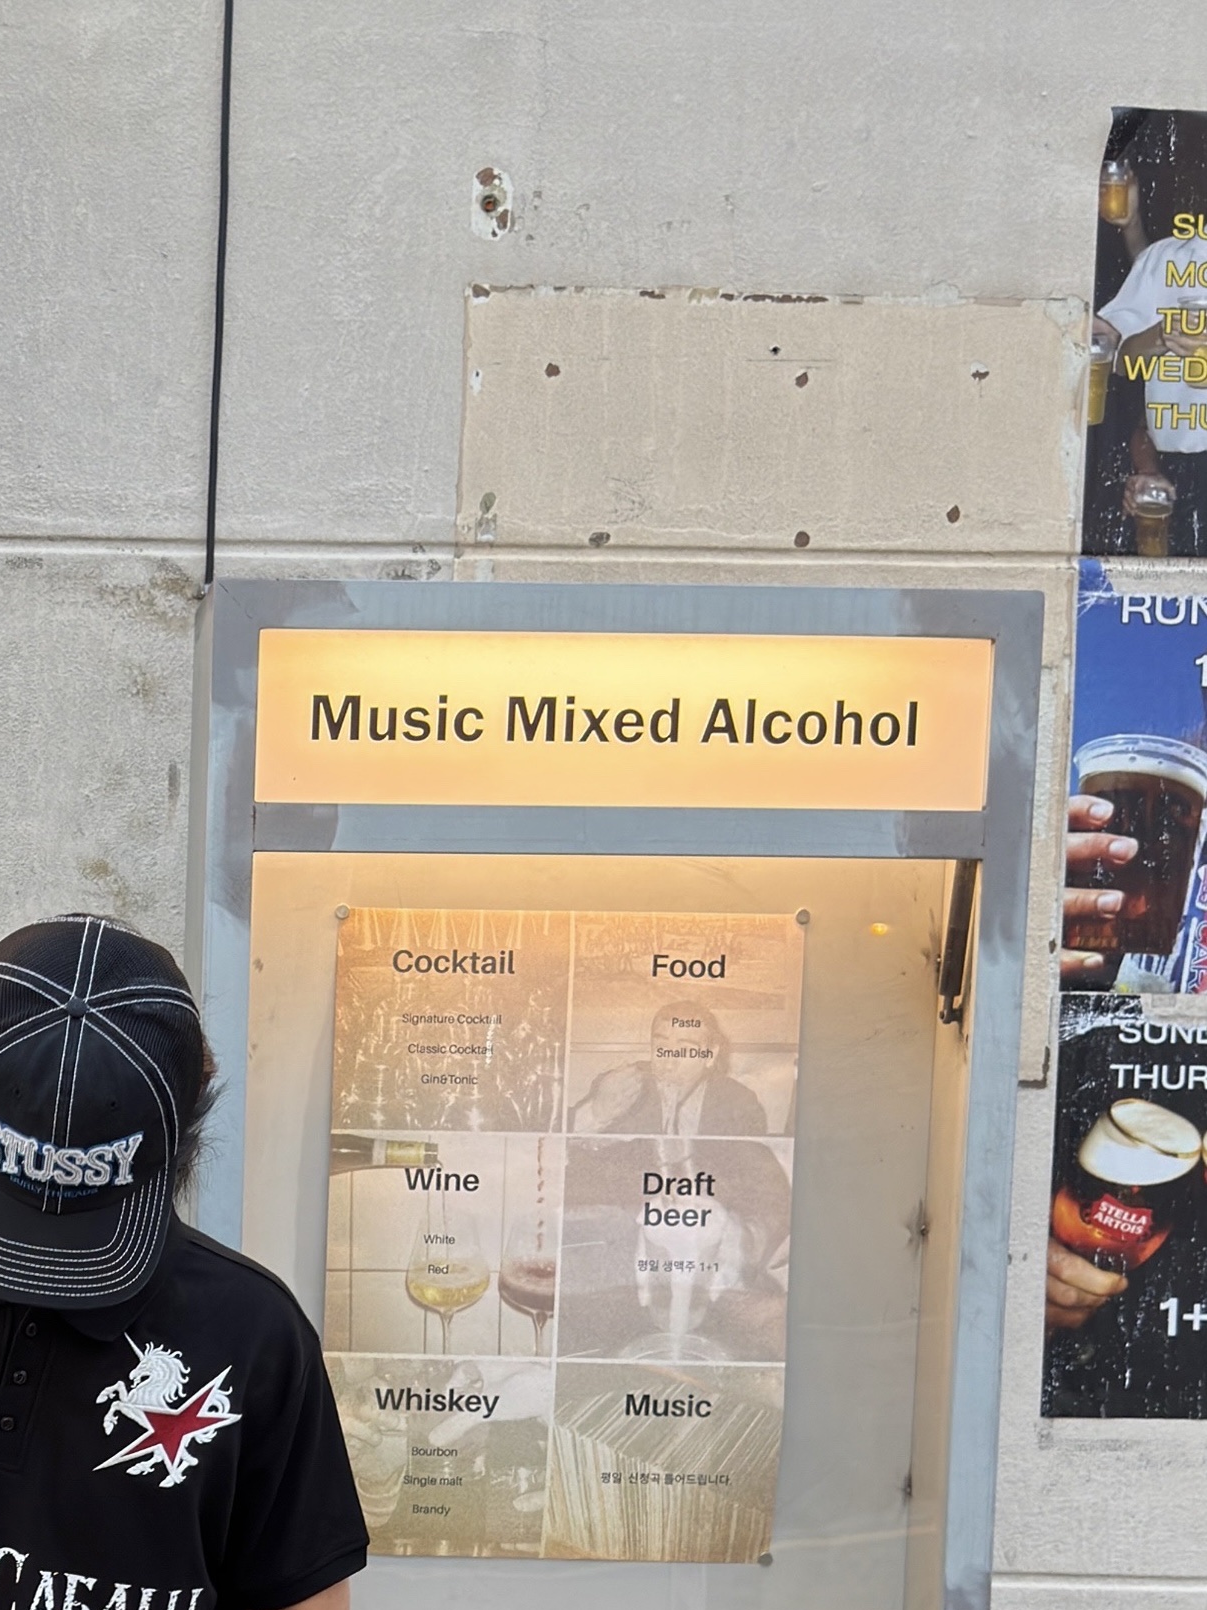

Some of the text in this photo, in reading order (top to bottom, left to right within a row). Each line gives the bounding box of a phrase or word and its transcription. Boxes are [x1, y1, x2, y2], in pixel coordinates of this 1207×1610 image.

[1123, 355, 1207, 382] WED
[311, 695, 918, 746] Music Mixed Alcohol
[392, 949, 515, 975] Cocktail
[652, 954, 726, 978] Food
[402, 1013, 455, 1026] Signature
[671, 1017, 701, 1028] Pasta
[407, 1043, 494, 1055] Classic Cocktal
[656, 1047, 713, 1059] Small Dish
[421, 1074, 478, 1085] Gin&Tonic
[1109, 1064, 1207, 1090] THUR
[404, 1168, 480, 1192] Wine
[643, 1172, 715, 1196] Draft
[644, 1202, 712, 1227] beer
[1093, 1211, 1144, 1235] ARTOIS
[1099, 1200, 1147, 1226] STELLA
[423, 1234, 456, 1245] White
[427, 1264, 449, 1275] Red
[637, 1260, 719, 1273] 평일 생맥주 1+1
[1159, 1297, 1207, 1336] 1+
[375, 1388, 499, 1419] Whiskey
[625, 1394, 711, 1418] Music
[411, 1446, 458, 1457] Bourbon
[403, 1475, 463, 1487] Single malt
[601, 1472, 623, 1484] 평일
[413, 1504, 451, 1517] Brandy
